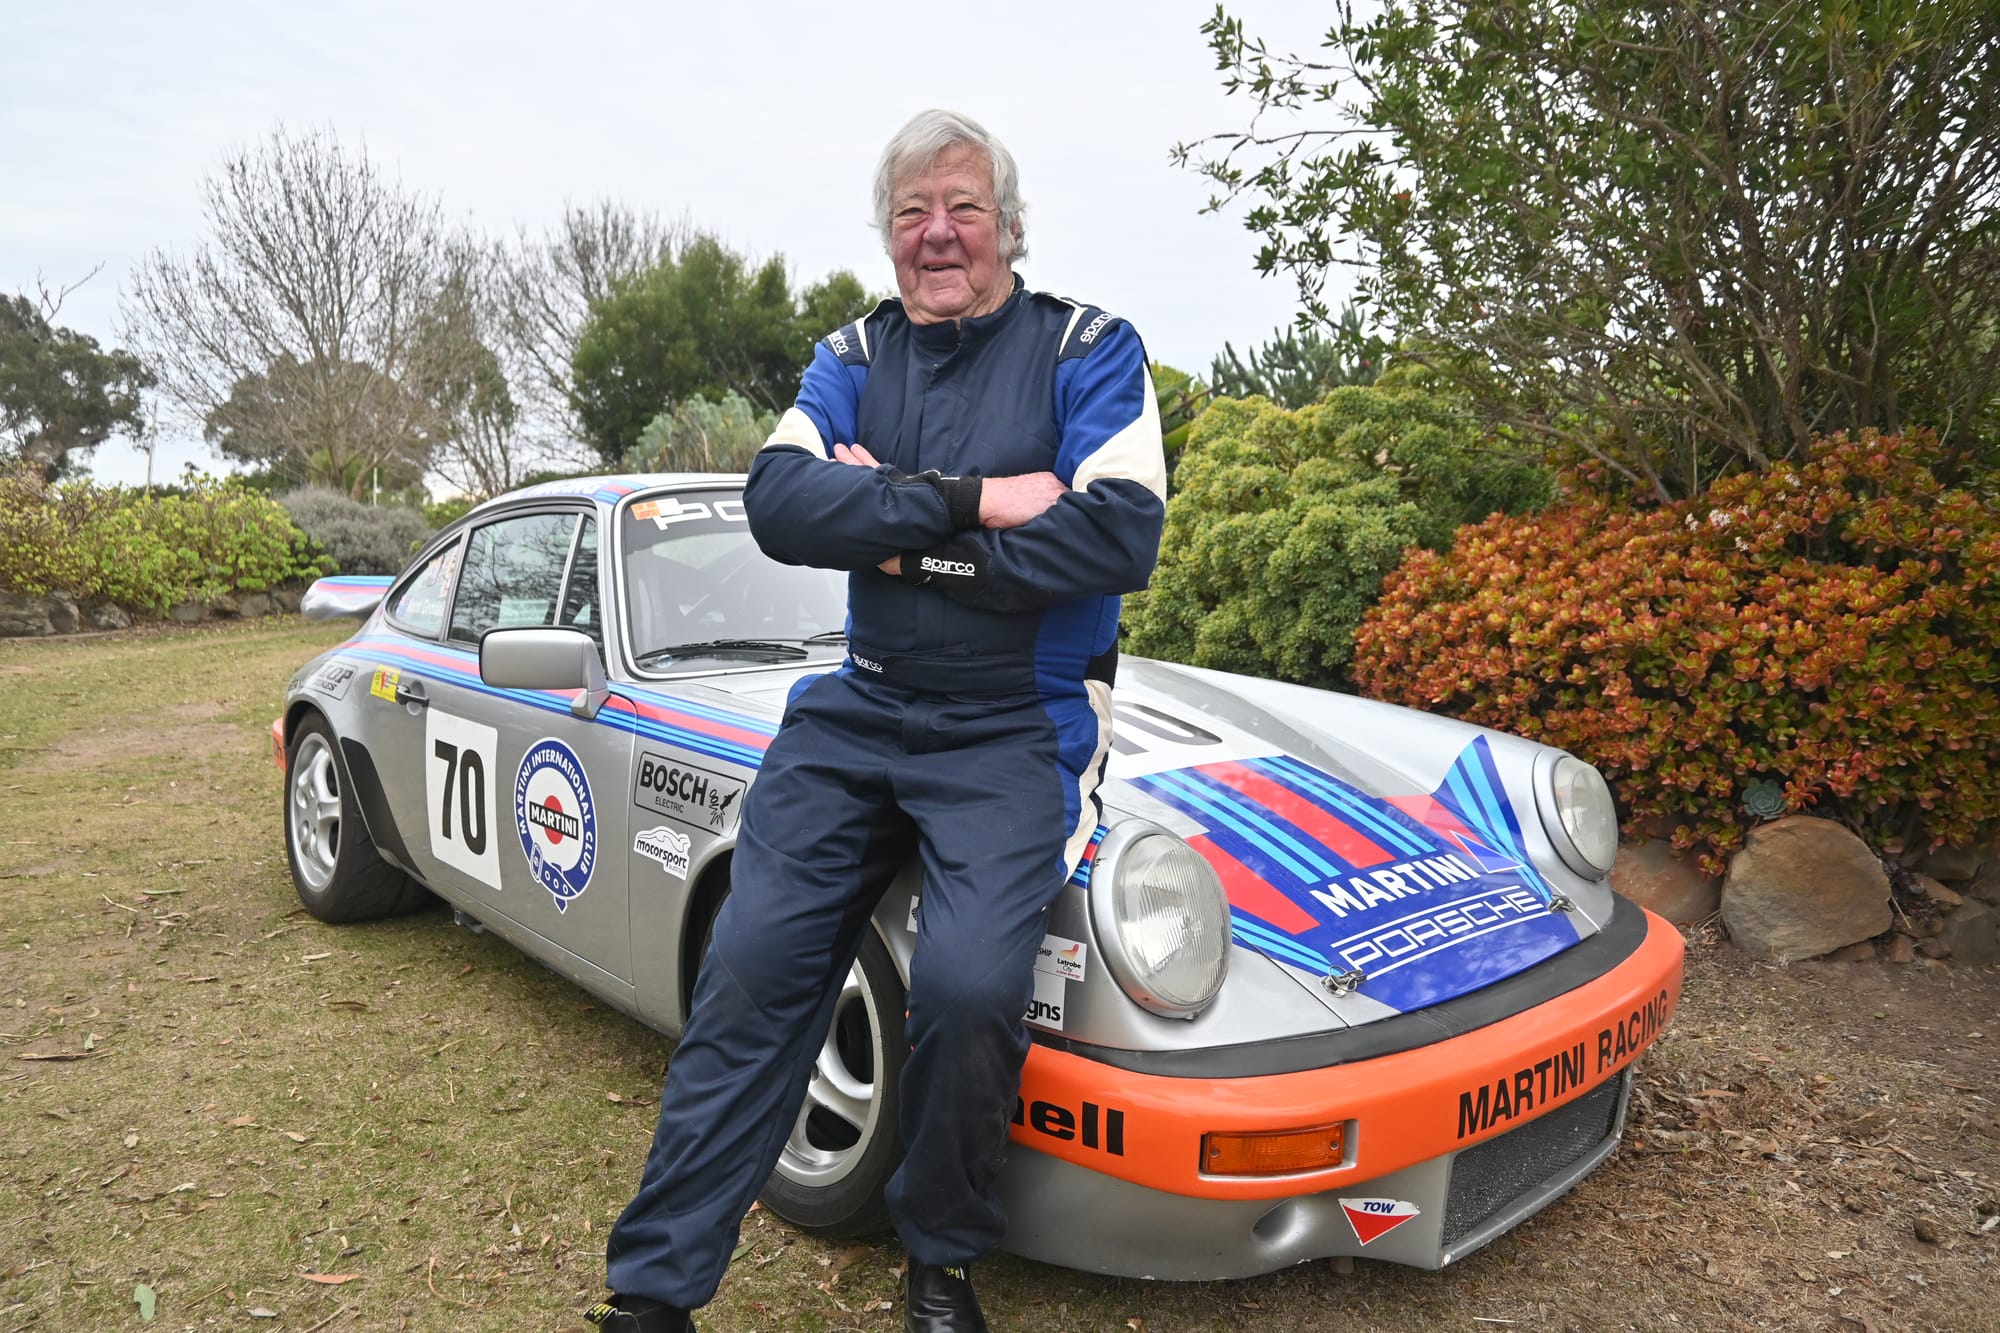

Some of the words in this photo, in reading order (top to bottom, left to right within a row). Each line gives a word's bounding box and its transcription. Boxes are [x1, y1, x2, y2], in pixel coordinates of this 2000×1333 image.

[921, 556, 975, 576] sparco
[434, 738, 487, 856] 70
[640, 760, 708, 806] BOSCH
[517, 763, 531, 835] MARTINI
[531, 749, 592, 824] INTERNATIONAL
[580, 831, 593, 875] CLUB
[531, 804, 577, 836] MARTINI
[655, 796, 684, 813] ELECTRIC
[636, 839, 687, 869] motorsport
[1309, 854, 1481, 918] MARTINI
[1339, 890, 1544, 972] PORSCHE
[1057, 957, 1081, 969] Latrobe
[1062, 966, 1073, 974] City
[1457, 1042, 1585, 1140] MARTINI
[1598, 989, 1668, 1074] RACING
[1363, 1202, 1395, 1214] TOW
